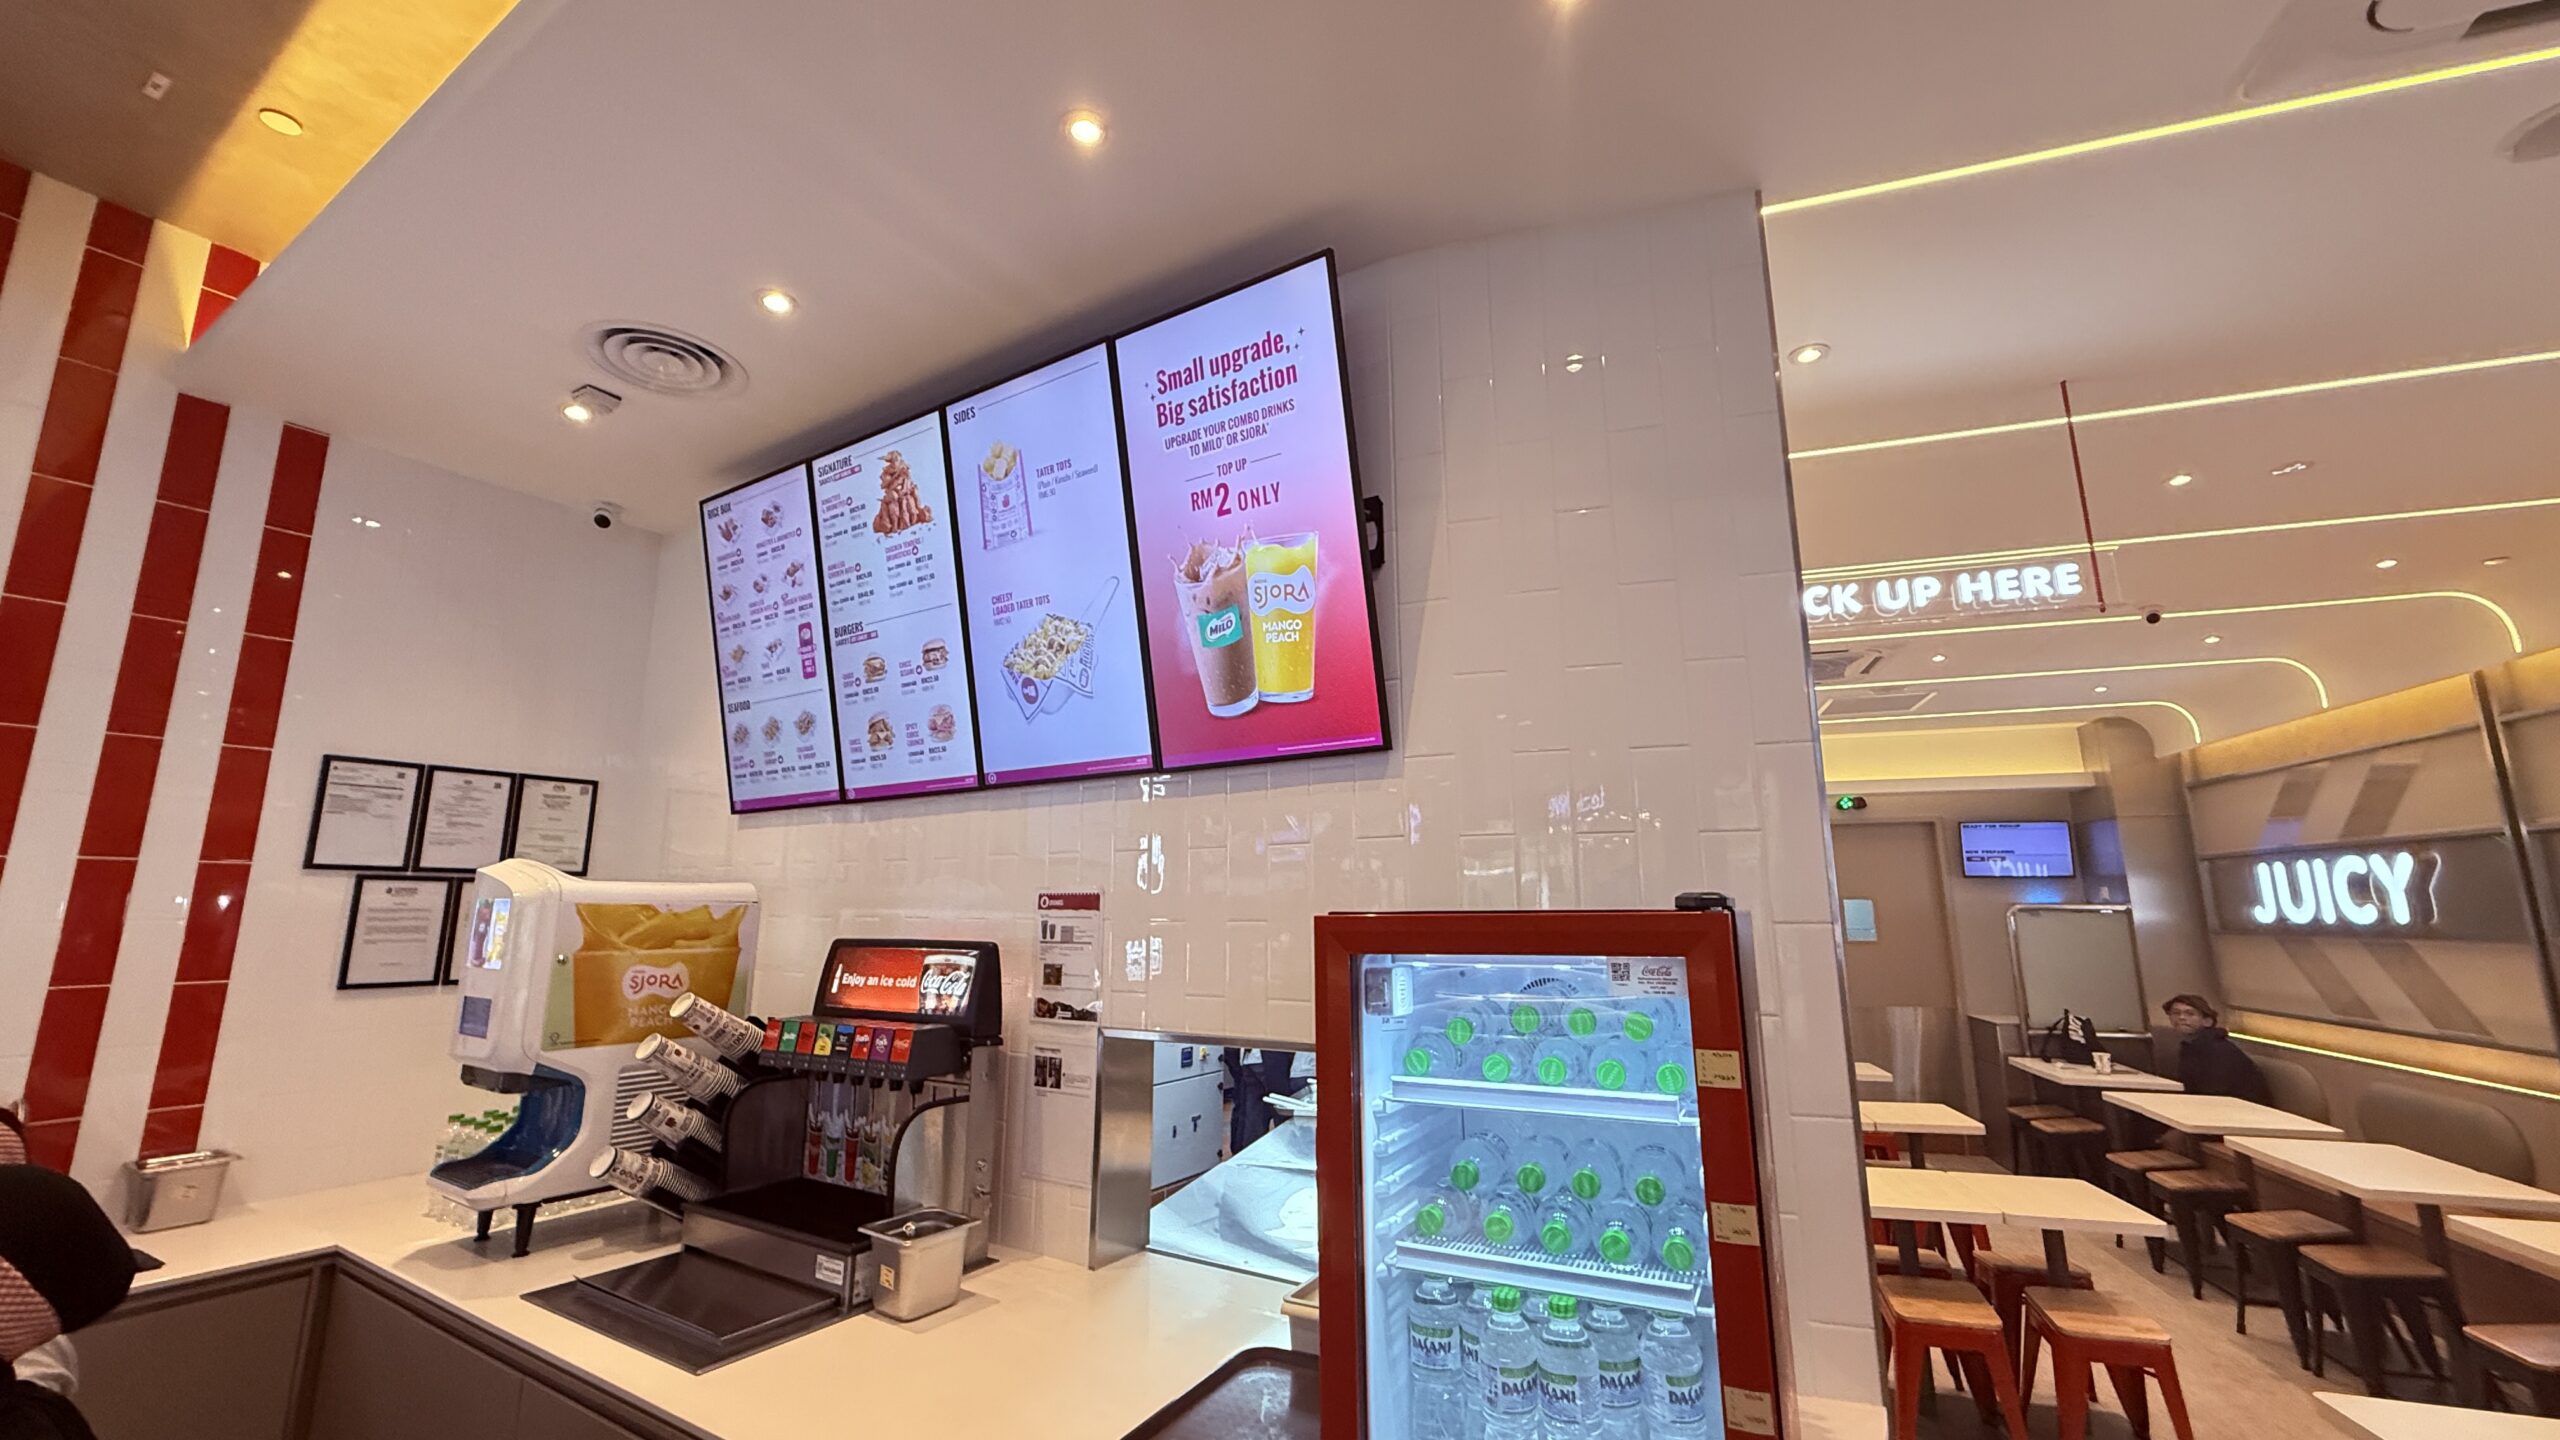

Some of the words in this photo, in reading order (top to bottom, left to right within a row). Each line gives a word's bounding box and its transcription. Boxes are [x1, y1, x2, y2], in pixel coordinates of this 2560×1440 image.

[1156, 356, 1205, 395] Small
[1209, 331, 1290, 377] upgrade,
[1156, 401, 1185, 428] Big
[1188, 364, 1298, 417] satisfaction
[953, 406, 976, 425] SIDES
[1164, 428, 1202, 450] UPGRADE
[1203, 421, 1226, 438] YOUR
[1228, 411, 1260, 431] COMBO
[1261, 398, 1295, 420] DRINKS
[1189, 444, 1201, 457] TO
[1226, 432, 1239, 445] OR
[817, 454, 853, 478] SIGNATURE
[1036, 465, 1055, 479] TATER
[1056, 458, 1072, 472] TOTS
[1217, 462, 1233, 477] TOP
[1235, 458, 1247, 473] UP
[1237, 481, 1281, 511] ONLY
[991, 592, 1013, 606] CHEESY
[1253, 582, 1310, 610] SJORA
[1803, 582, 1863, 616] CK
[1875, 575, 1942, 611] UP
[1956, 562, 2083, 605] HERE
[992, 602, 1016, 616] LOADED
[1016, 598, 1034, 612] TATER
[1035, 594, 1050, 608] TOTS
[834, 621, 864, 638] BURGERS
[1262, 618, 1303, 632] MANGO
[1265, 631, 1299, 644] PEACH
[727, 700, 751, 714] SEAFOOD
[2253, 851, 2414, 926] JUICY
[1642, 965, 1672, 976] Coca-Cola
[629, 972, 683, 994] SJORA
[842, 972, 865, 988] Enjoy
[866, 976, 878, 986] an
[879, 974, 894, 986] ice
[895, 975, 917, 988] cold
[920, 969, 970, 996] Coca-Cola
[627, 1004, 670, 1016] MANG
[629, 1014, 673, 1027] PEACH
[1412, 1335, 1451, 1355] DASANI
[1539, 1379, 1577, 1404] ASANI
